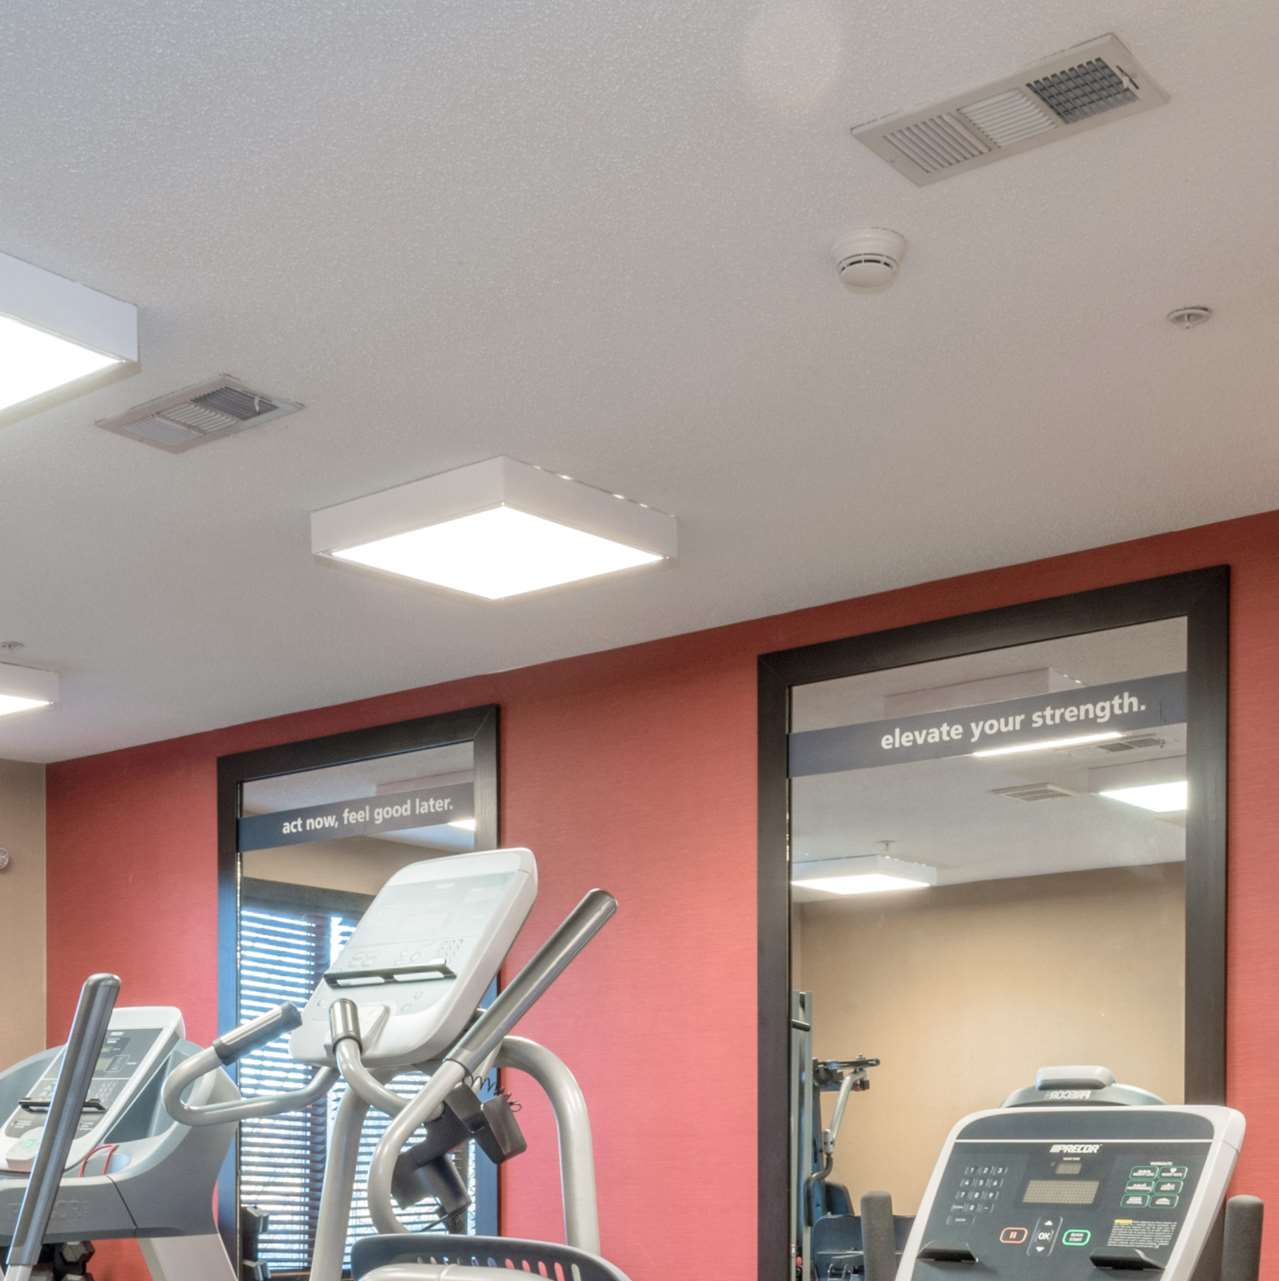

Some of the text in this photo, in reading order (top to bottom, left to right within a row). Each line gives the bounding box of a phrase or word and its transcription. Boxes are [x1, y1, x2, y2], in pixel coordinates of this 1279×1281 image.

[880, 691, 1146, 750] elevate your strength.
[282, 796, 454, 835] act now, feel good later.
[1053, 1144, 1100, 1154] PRECOR
